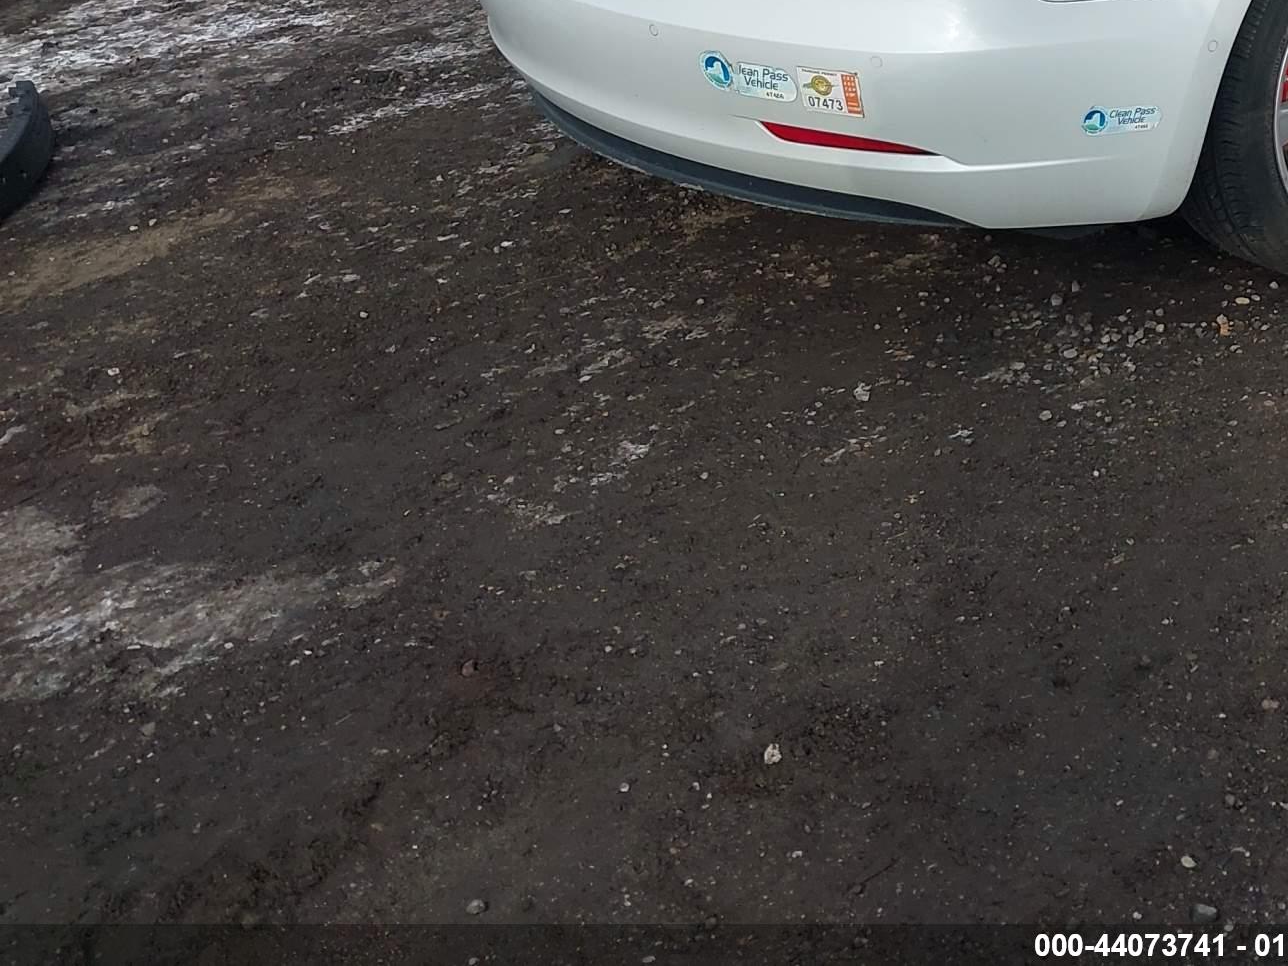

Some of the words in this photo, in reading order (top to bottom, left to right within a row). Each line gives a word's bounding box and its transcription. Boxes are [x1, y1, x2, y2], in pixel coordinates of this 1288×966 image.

[763, 68, 789, 82] Pass
[744, 75, 779, 91] Vehicle
[808, 96, 843, 111] 07473
[1109, 110, 1132, 118] Clean
[1134, 107, 1157, 117] Pass
[1118, 117, 1146, 125] Vehicle
